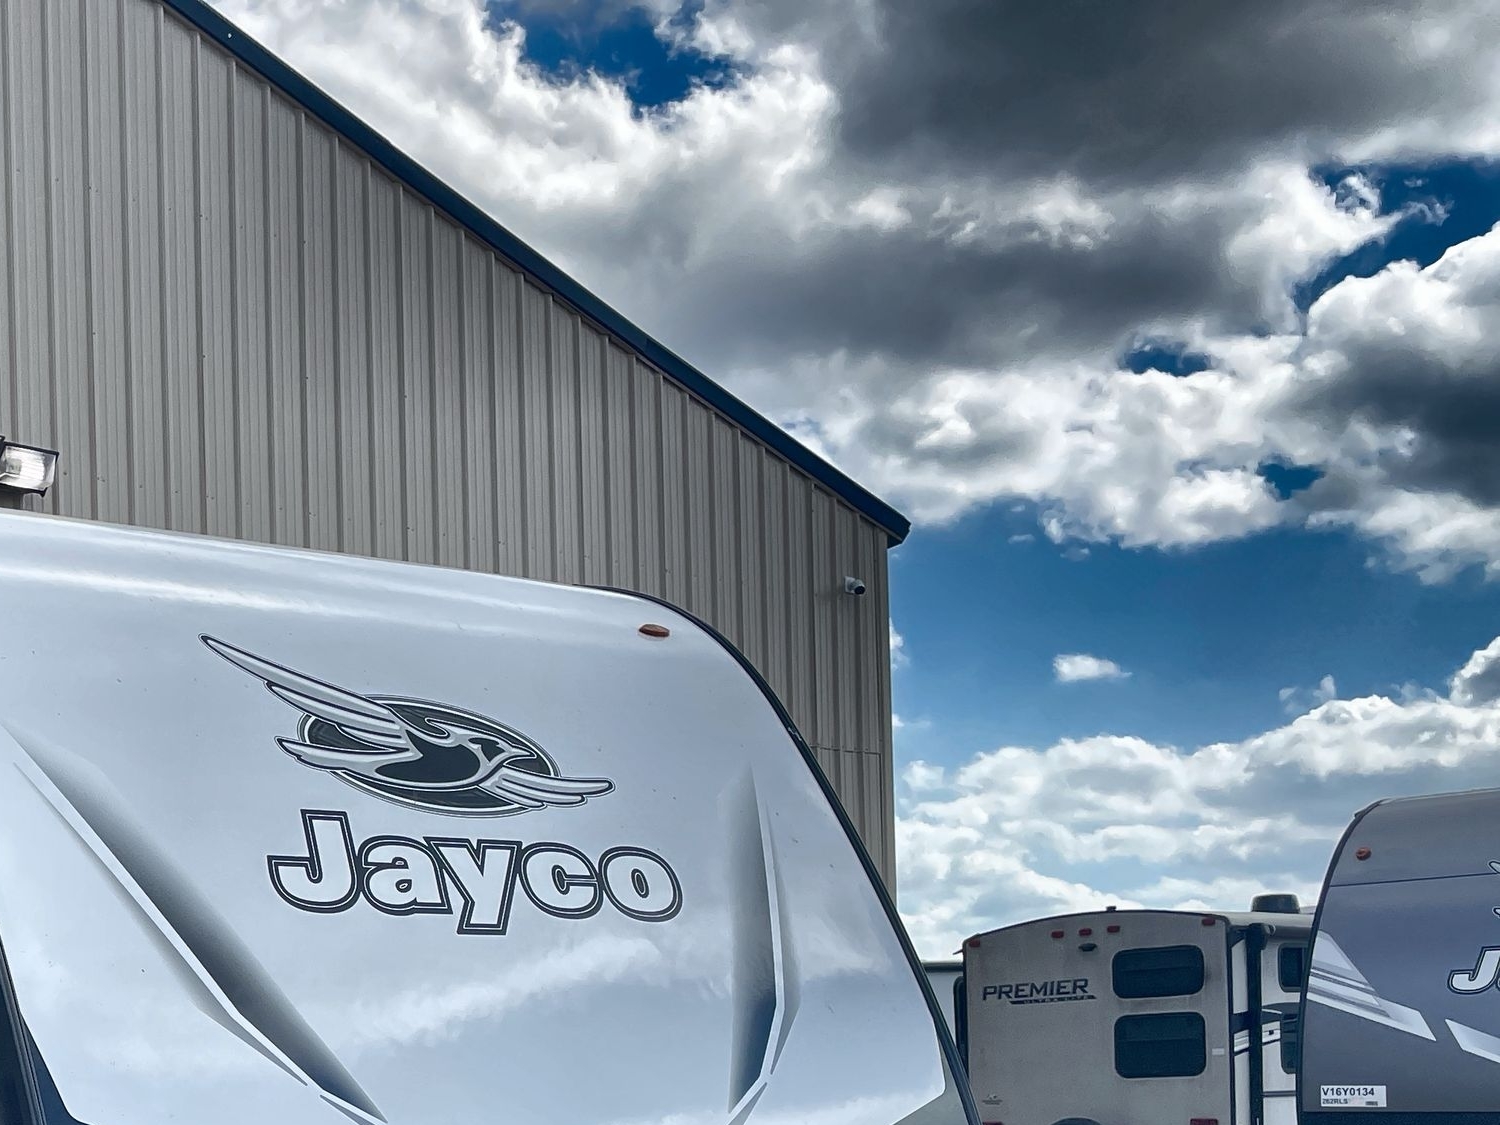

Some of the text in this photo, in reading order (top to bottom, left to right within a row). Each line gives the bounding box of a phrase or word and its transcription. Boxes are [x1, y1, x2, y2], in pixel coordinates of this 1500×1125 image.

[266, 808, 683, 935] Jayco
[982, 978, 1089, 1001] PREMIER
[1322, 1087, 1375, 1097] V16Y0134
